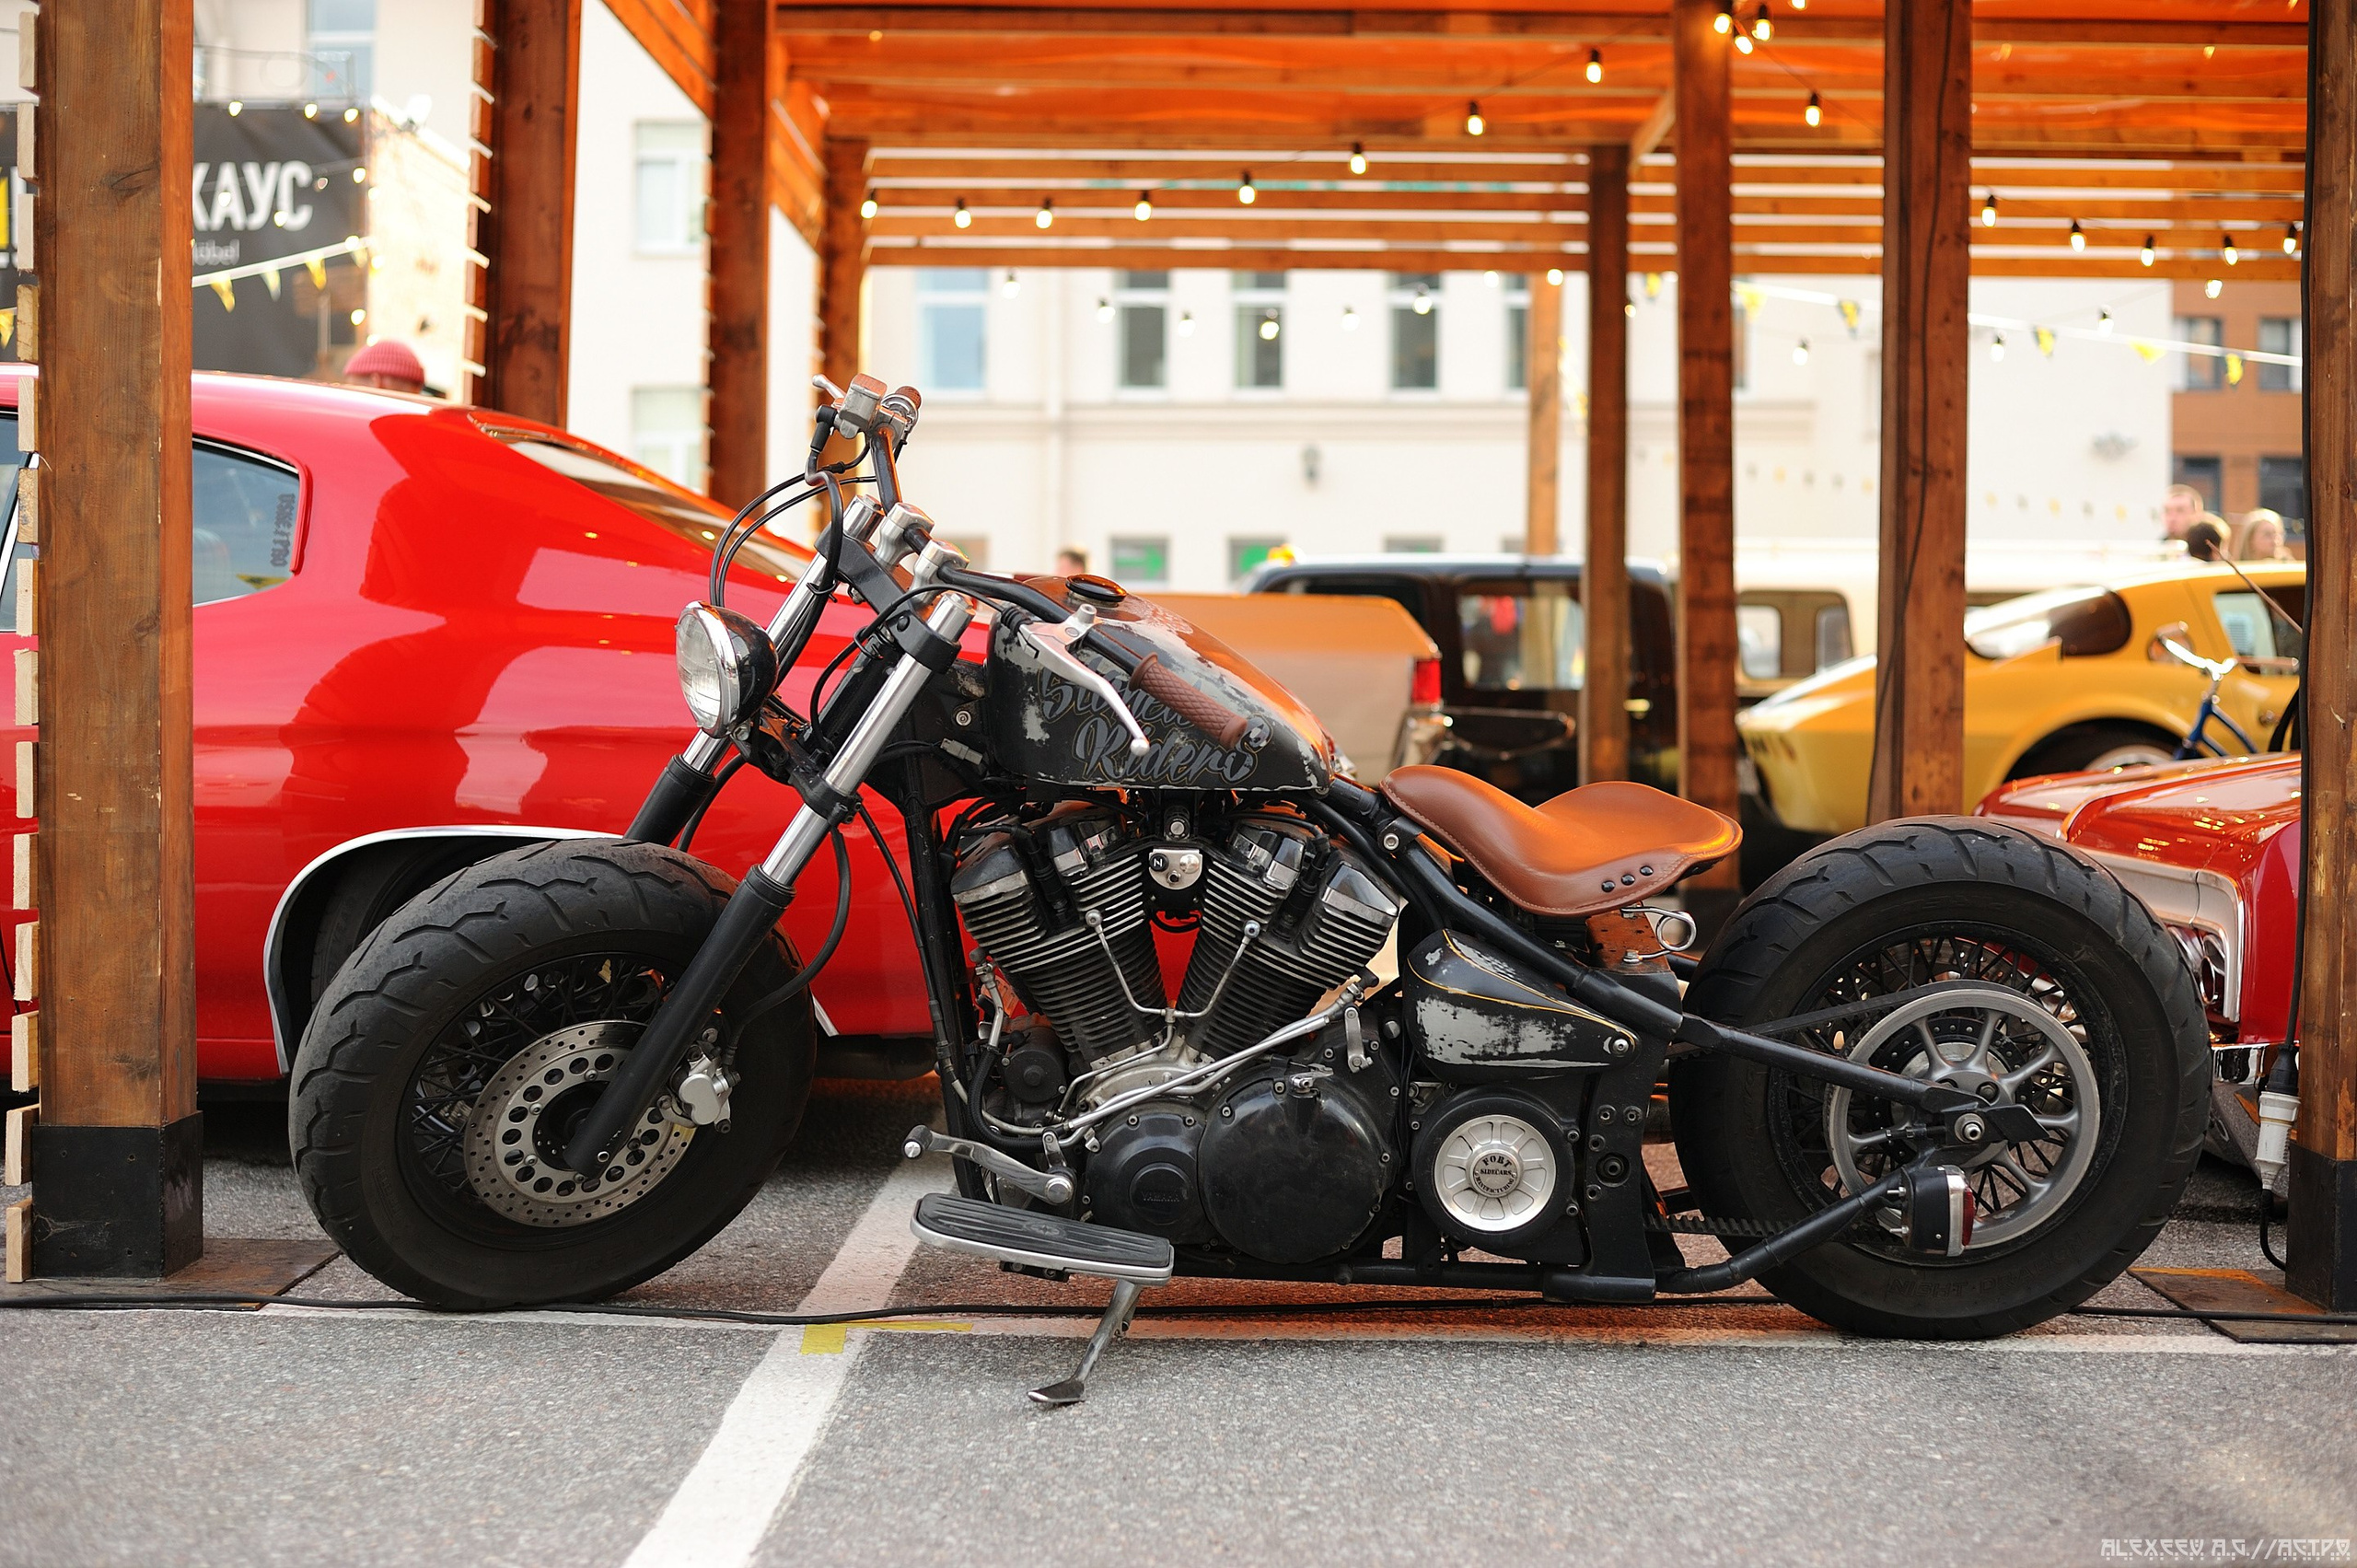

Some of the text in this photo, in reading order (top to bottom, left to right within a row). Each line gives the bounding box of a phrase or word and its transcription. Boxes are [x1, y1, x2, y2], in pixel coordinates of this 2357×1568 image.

[1073, 715, 1272, 784] Riders
[1482, 1156, 1513, 1167] FORT
[1480, 1167, 1513, 1177] SIDECARS
[1475, 1176, 1515, 1194] MANUFACTURING
[1888, 1230, 2086, 1299] NIGHT DRAGON
